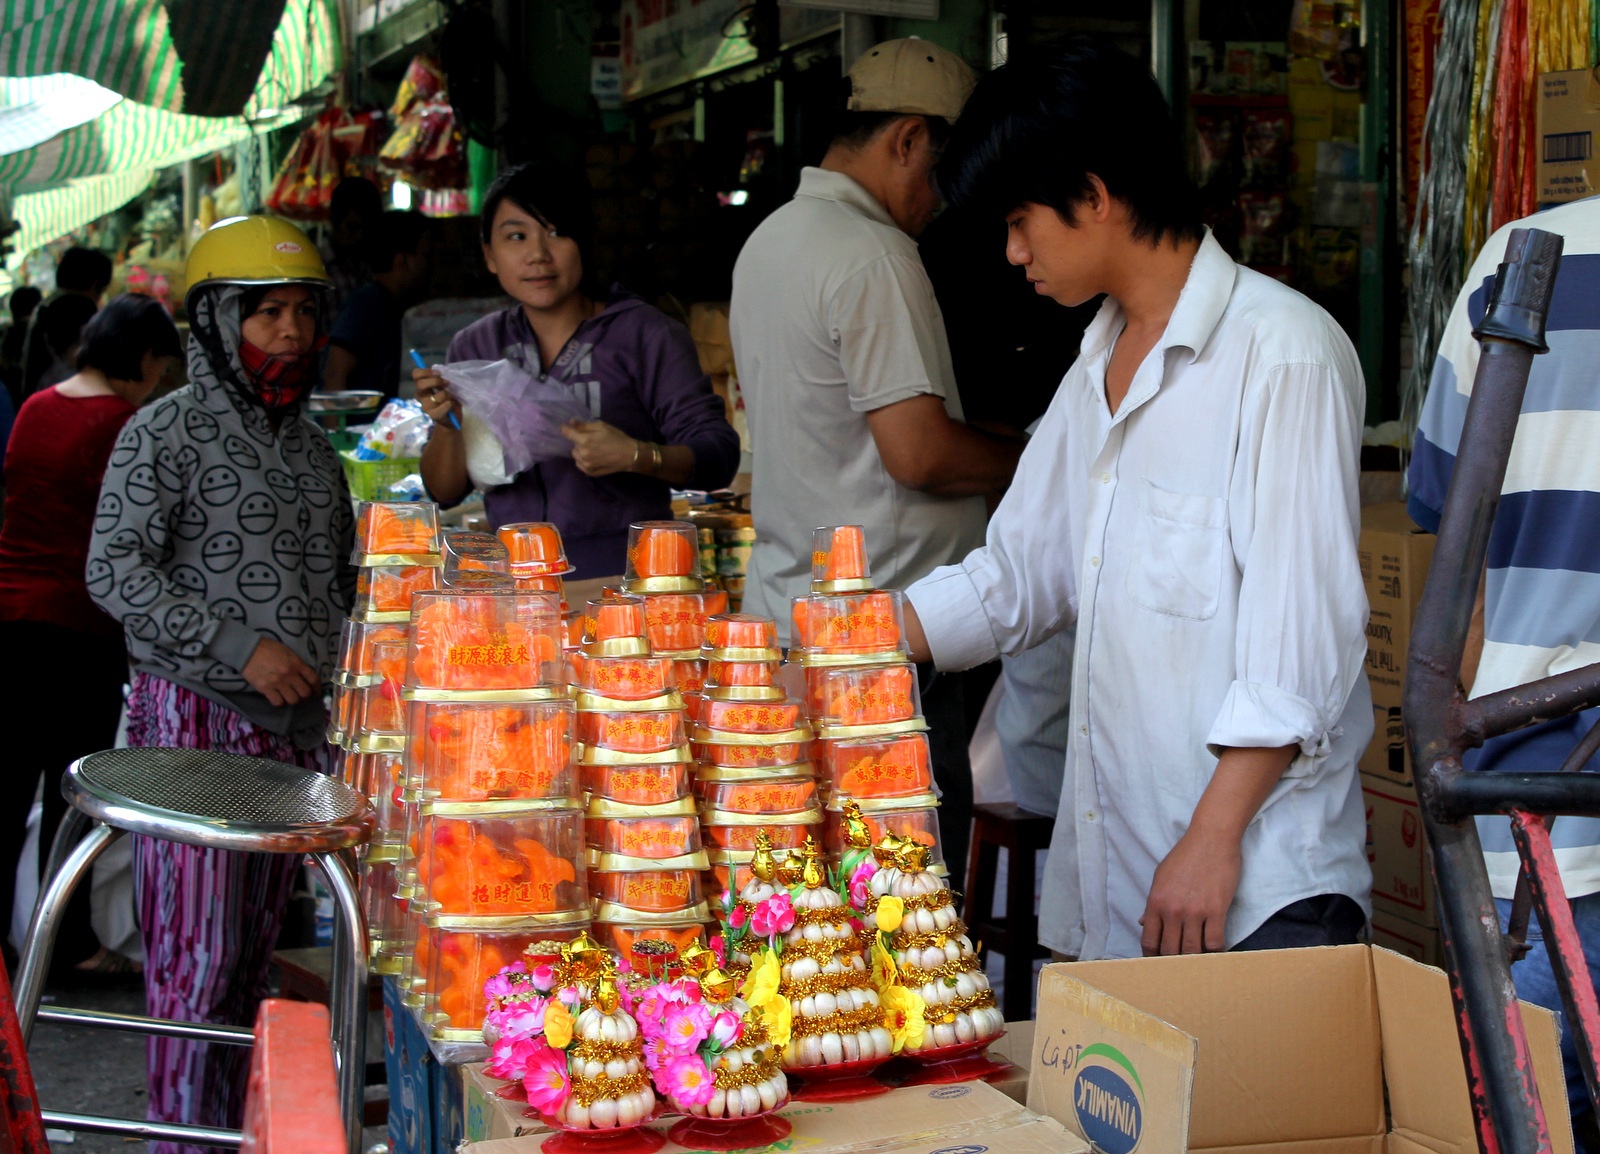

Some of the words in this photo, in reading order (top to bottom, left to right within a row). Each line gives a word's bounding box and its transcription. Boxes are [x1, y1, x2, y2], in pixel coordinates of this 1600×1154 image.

[450, 644, 531, 667] 財源滾滾來
[607, 719, 669, 738] 年年順利
[737, 790, 798, 809] 年年順利
[624, 831, 687, 848] 年年順利
[471, 882, 554, 904] 招財進寶
[626, 880, 689, 898] 年年順利
[1077, 1076, 1137, 1140] VINAMILK
